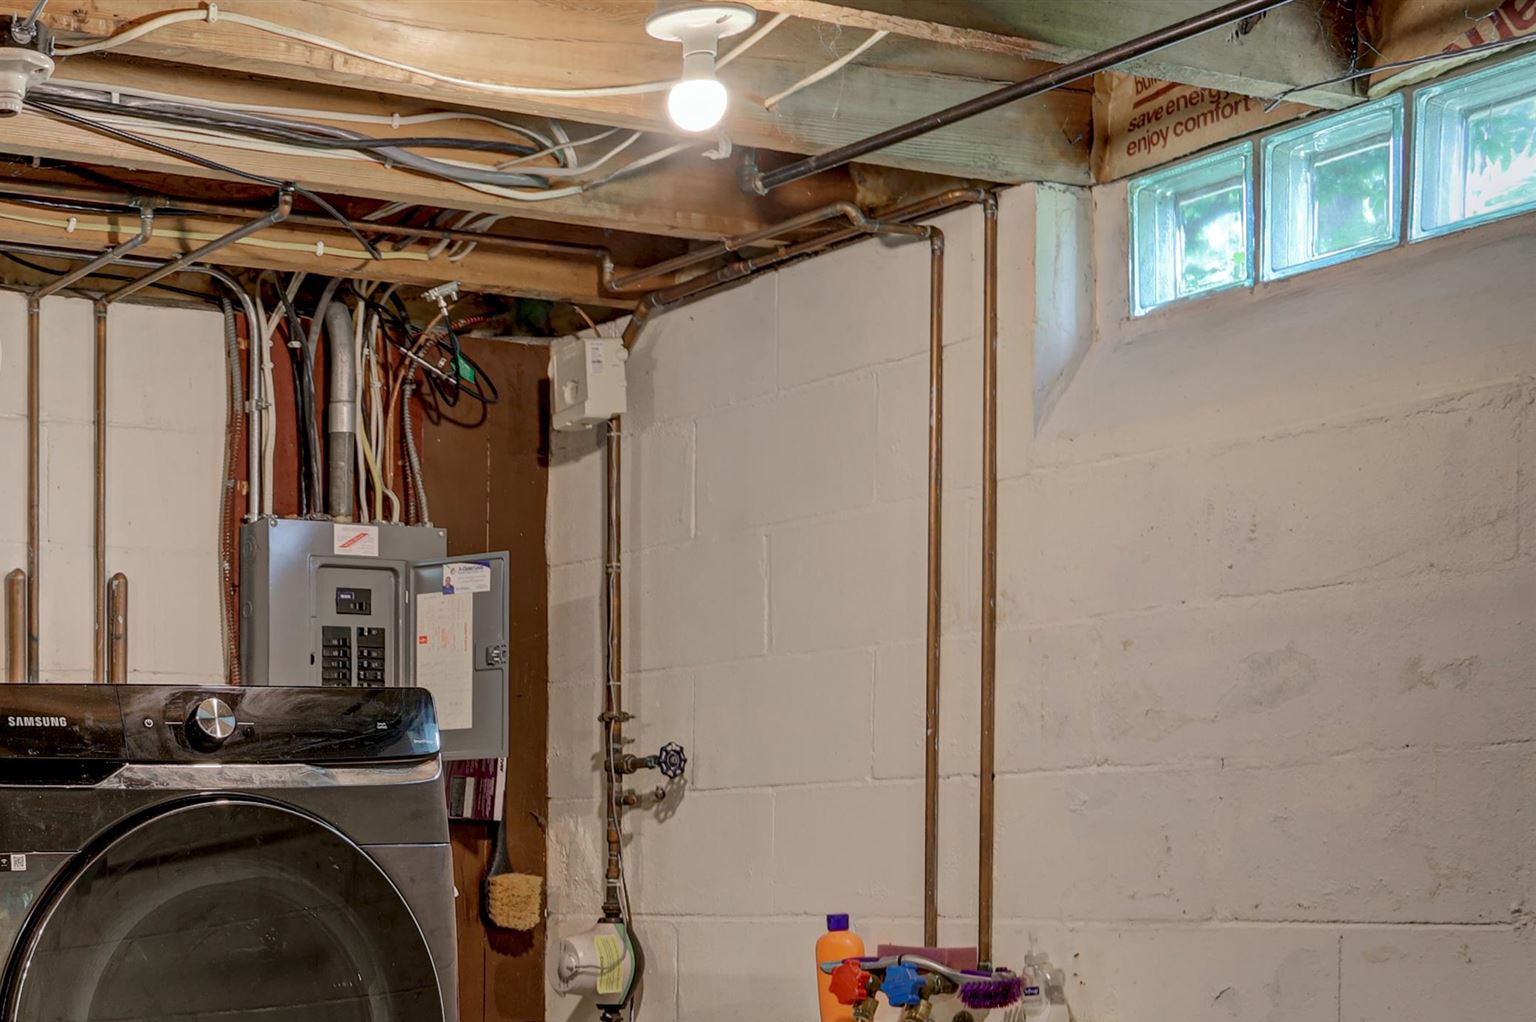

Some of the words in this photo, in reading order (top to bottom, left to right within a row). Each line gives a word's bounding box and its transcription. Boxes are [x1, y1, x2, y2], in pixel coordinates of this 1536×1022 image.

[1126, 126, 1169, 156] enjoy
[1173, 95, 1251, 137] comfort
[1128, 106, 1164, 133] save
[7, 716, 67, 727] SAMSUNG
